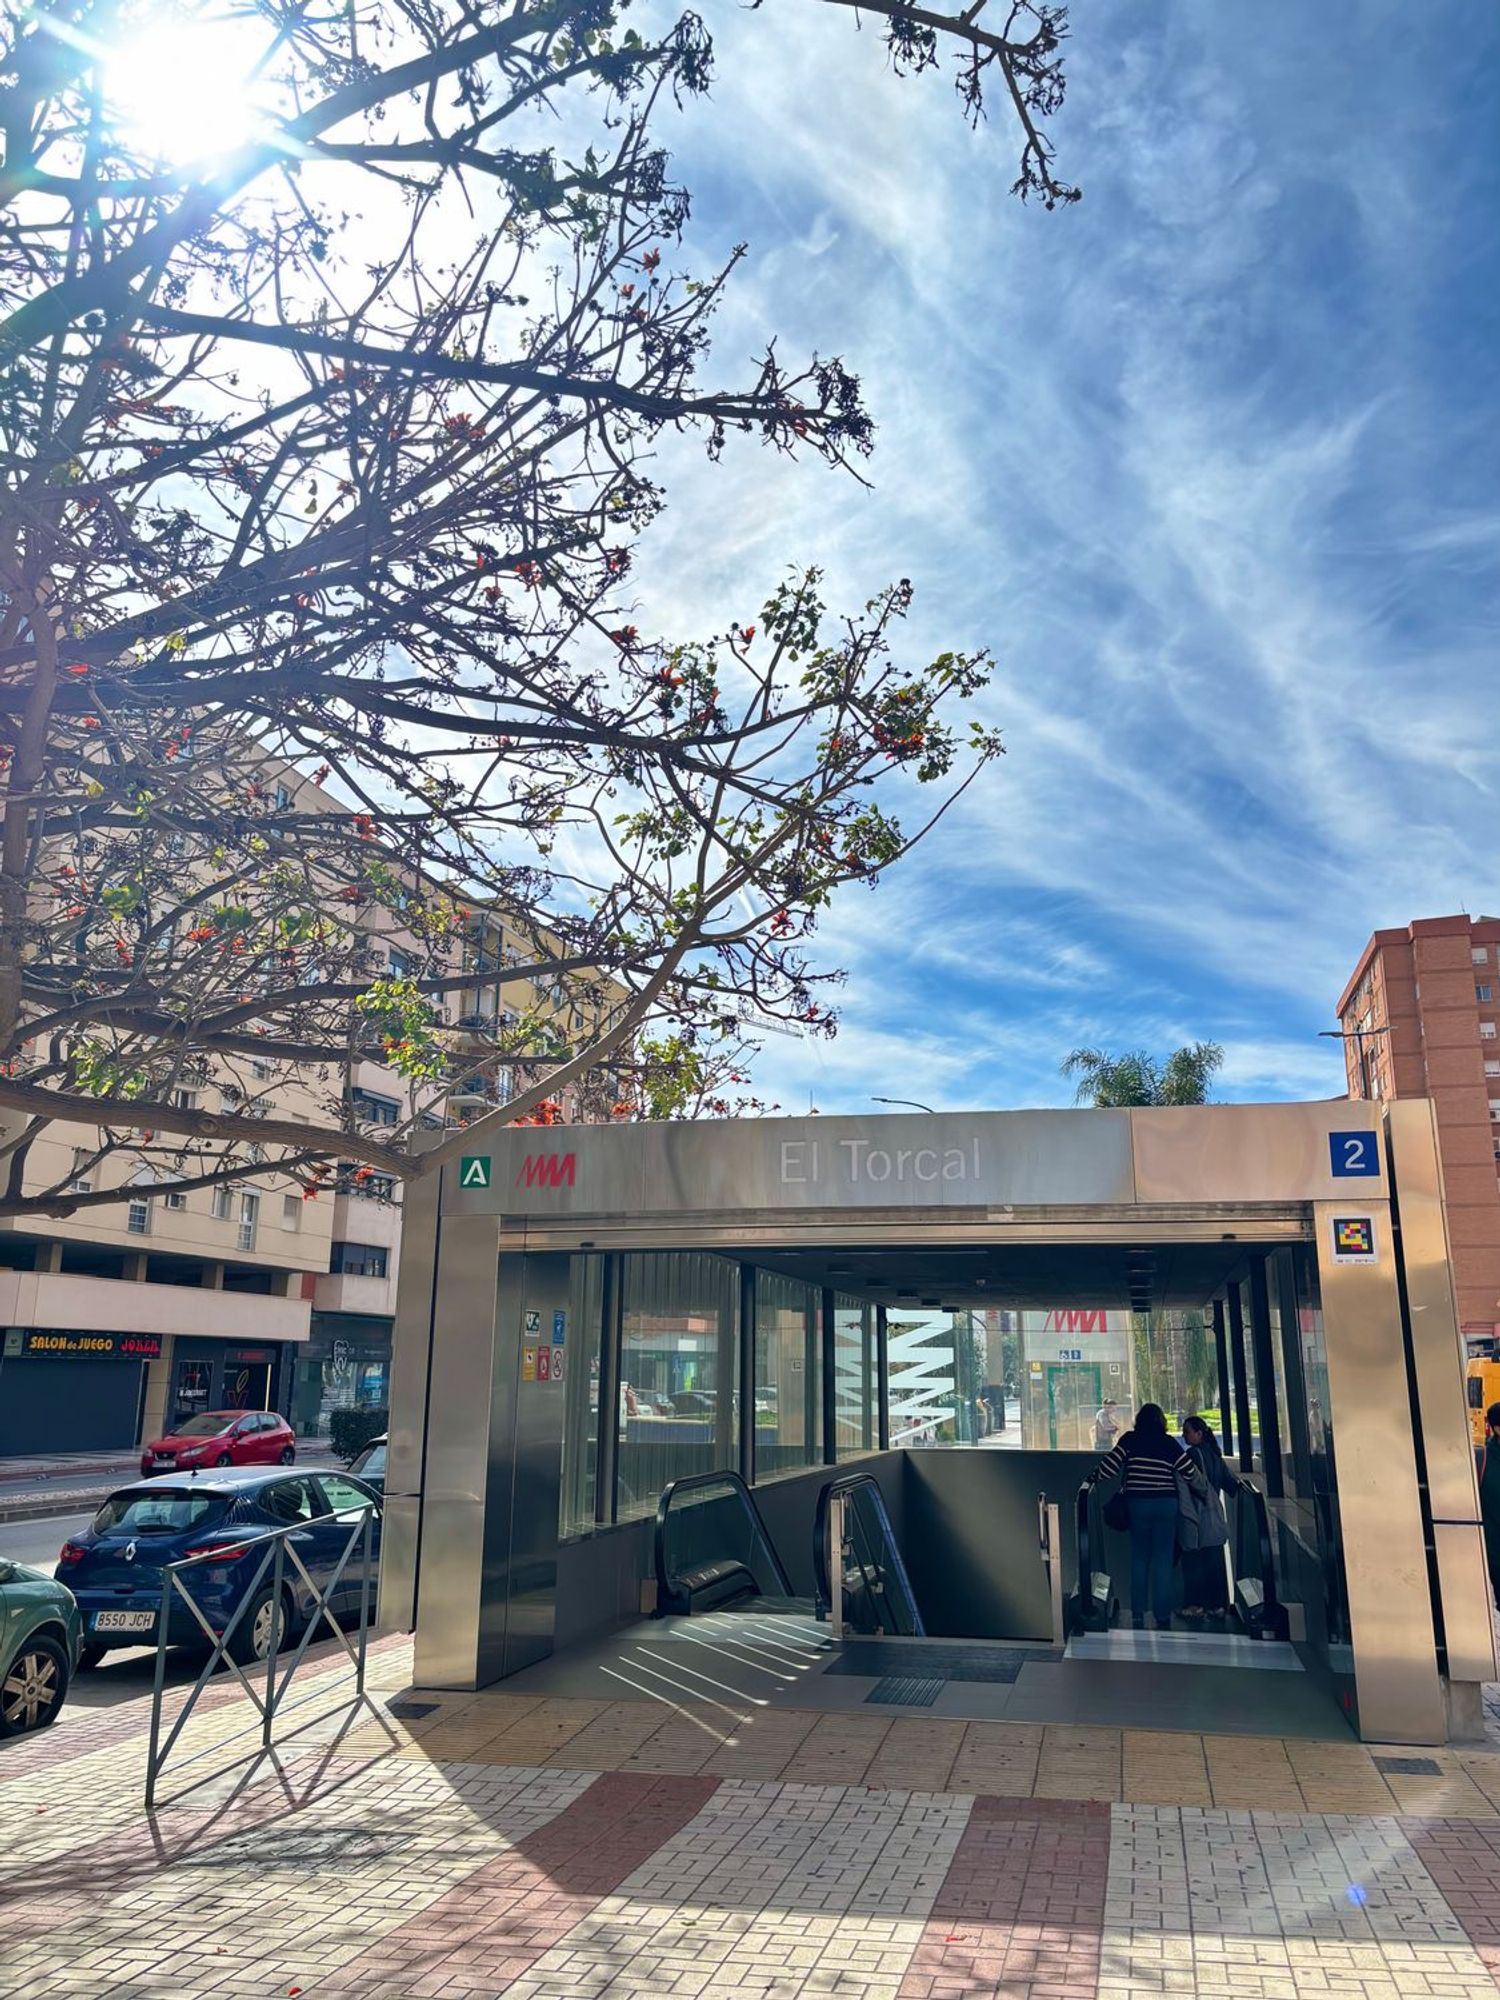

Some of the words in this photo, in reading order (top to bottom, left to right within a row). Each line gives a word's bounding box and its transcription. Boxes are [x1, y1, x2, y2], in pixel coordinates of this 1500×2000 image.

[781, 1140, 818, 1183] El
[839, 1137, 981, 1182] Torcal
[1343, 1139, 1366, 1169] 2
[29, 1336, 67, 1349] SALON
[78, 1338, 113, 1351] JUEGO
[97, 1613, 127, 1627] 8550
[129, 1613, 152, 1627] JCH
